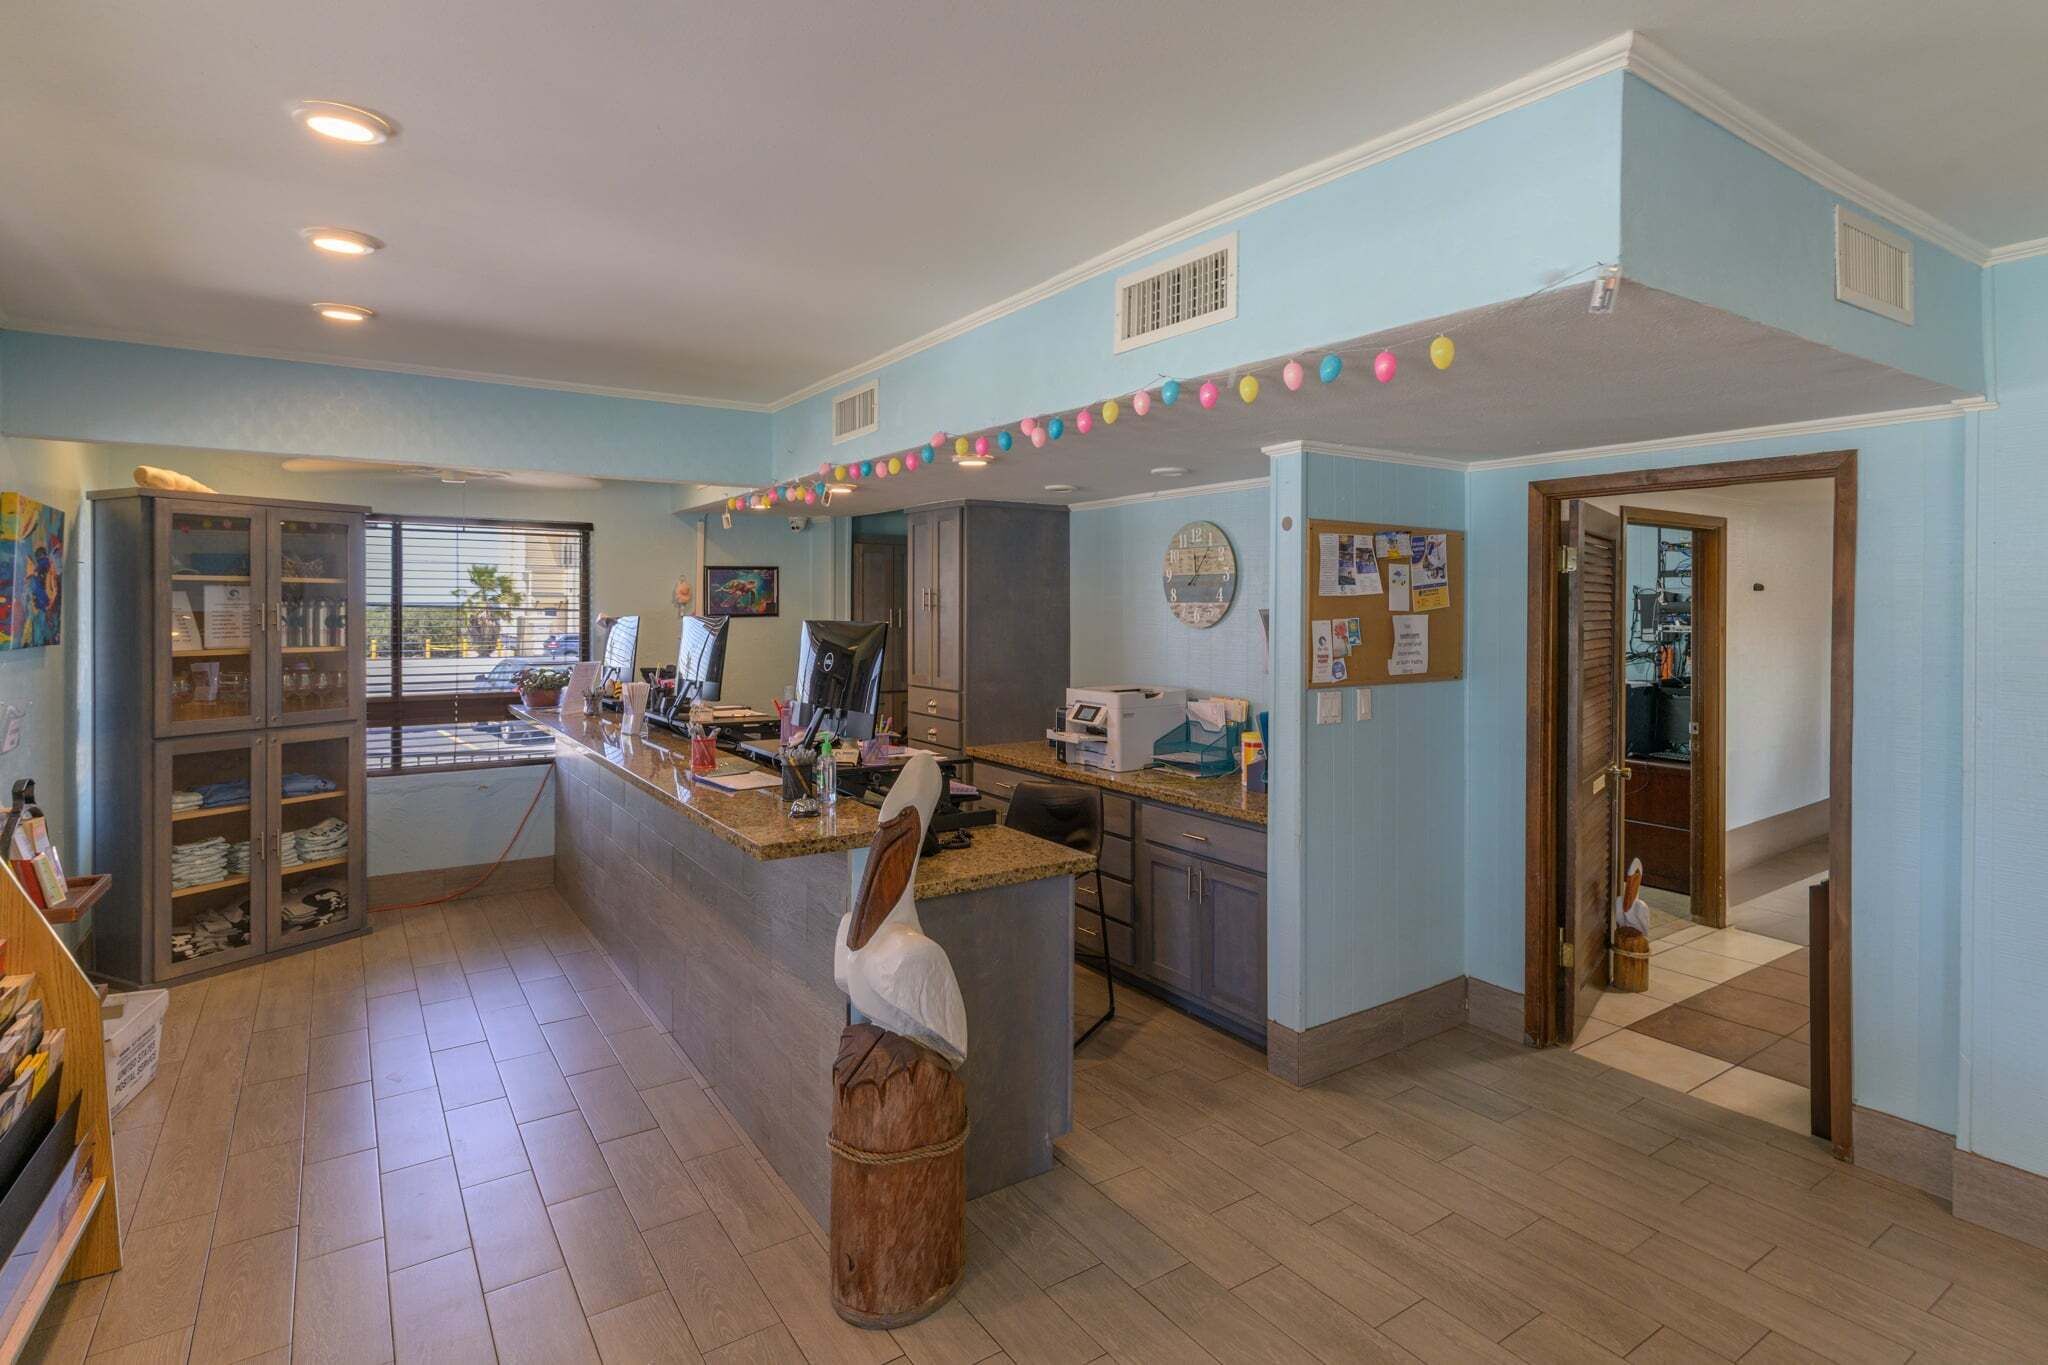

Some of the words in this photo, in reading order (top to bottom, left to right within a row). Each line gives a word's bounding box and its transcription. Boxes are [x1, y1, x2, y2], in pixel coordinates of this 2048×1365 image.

[1179, 534, 1188, 549] 11
[1191, 528, 1202, 543] 12
[1208, 532, 1213, 547] 1
[1169, 549, 1180, 564] 10
[1217, 547, 1226, 561] 2
[1166, 568, 1174, 583] 9
[1223, 567, 1231, 582] 3
[1170, 587, 1178, 602] 8
[1215, 587, 1224, 602] 4
[1193, 608, 1201, 623] 6
